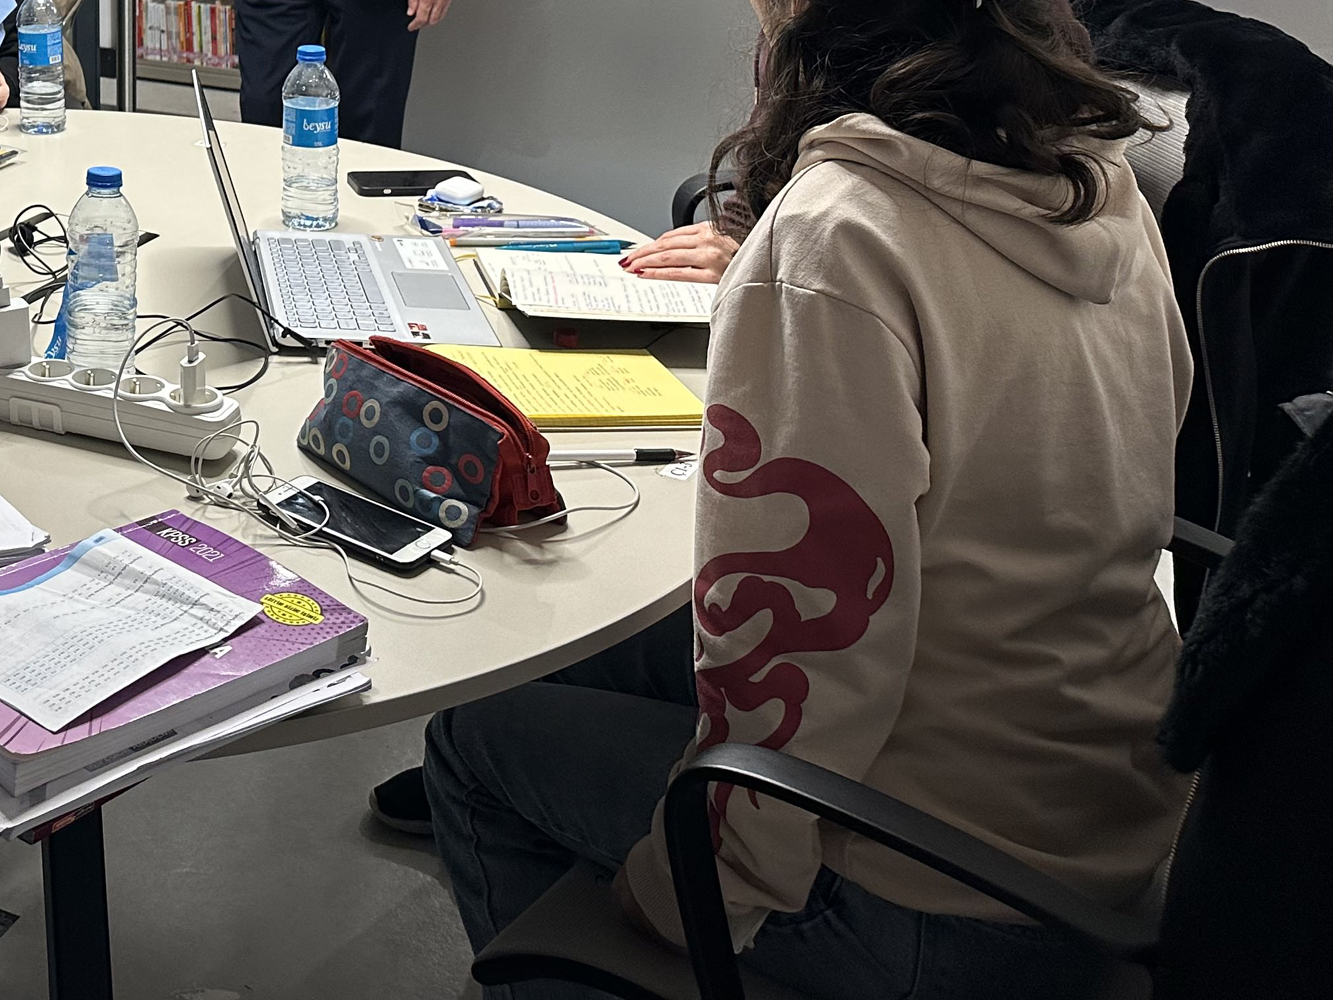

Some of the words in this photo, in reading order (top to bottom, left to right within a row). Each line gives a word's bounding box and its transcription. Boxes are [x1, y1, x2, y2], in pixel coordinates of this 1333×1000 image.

[303, 118, 332, 133] beysu
[155, 527, 197, 547] KPSS
[189, 543, 225, 562] 2021
